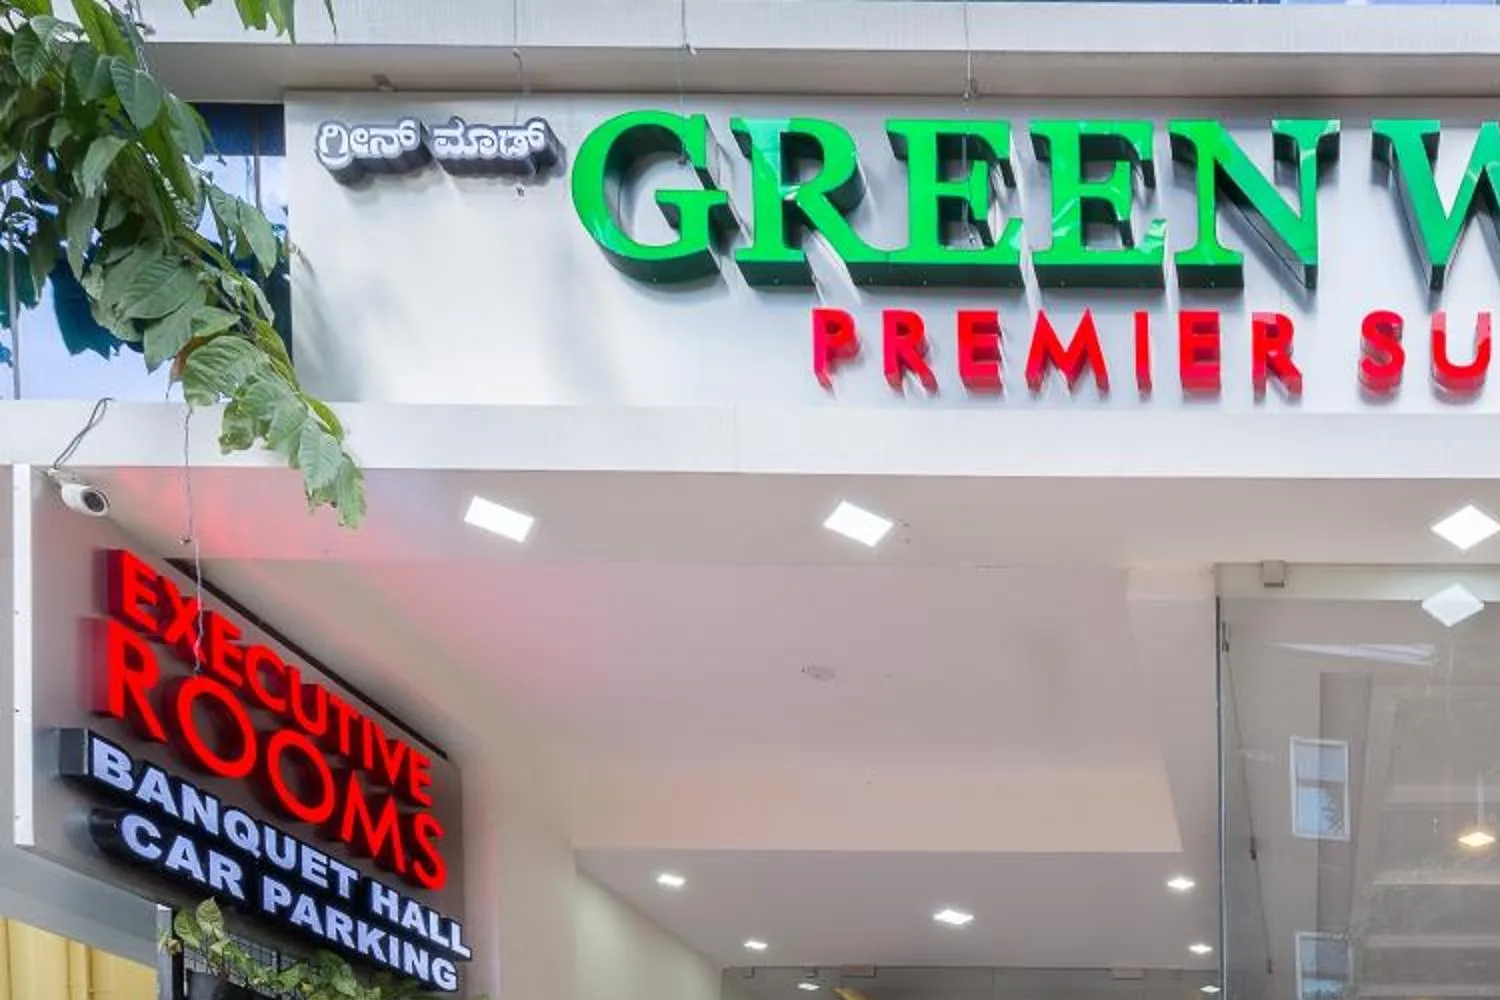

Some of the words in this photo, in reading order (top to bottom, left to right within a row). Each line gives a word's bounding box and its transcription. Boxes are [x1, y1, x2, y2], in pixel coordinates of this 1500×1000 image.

[811, 308, 1303, 395] PREMIER
[104, 619, 448, 891] ROOMS
[115, 549, 433, 806] EXECUTIVE
[91, 737, 361, 898] BANQUET
[370, 880, 472, 960] HALL
[120, 814, 245, 900] CAR
[262, 880, 460, 992] PARKING
